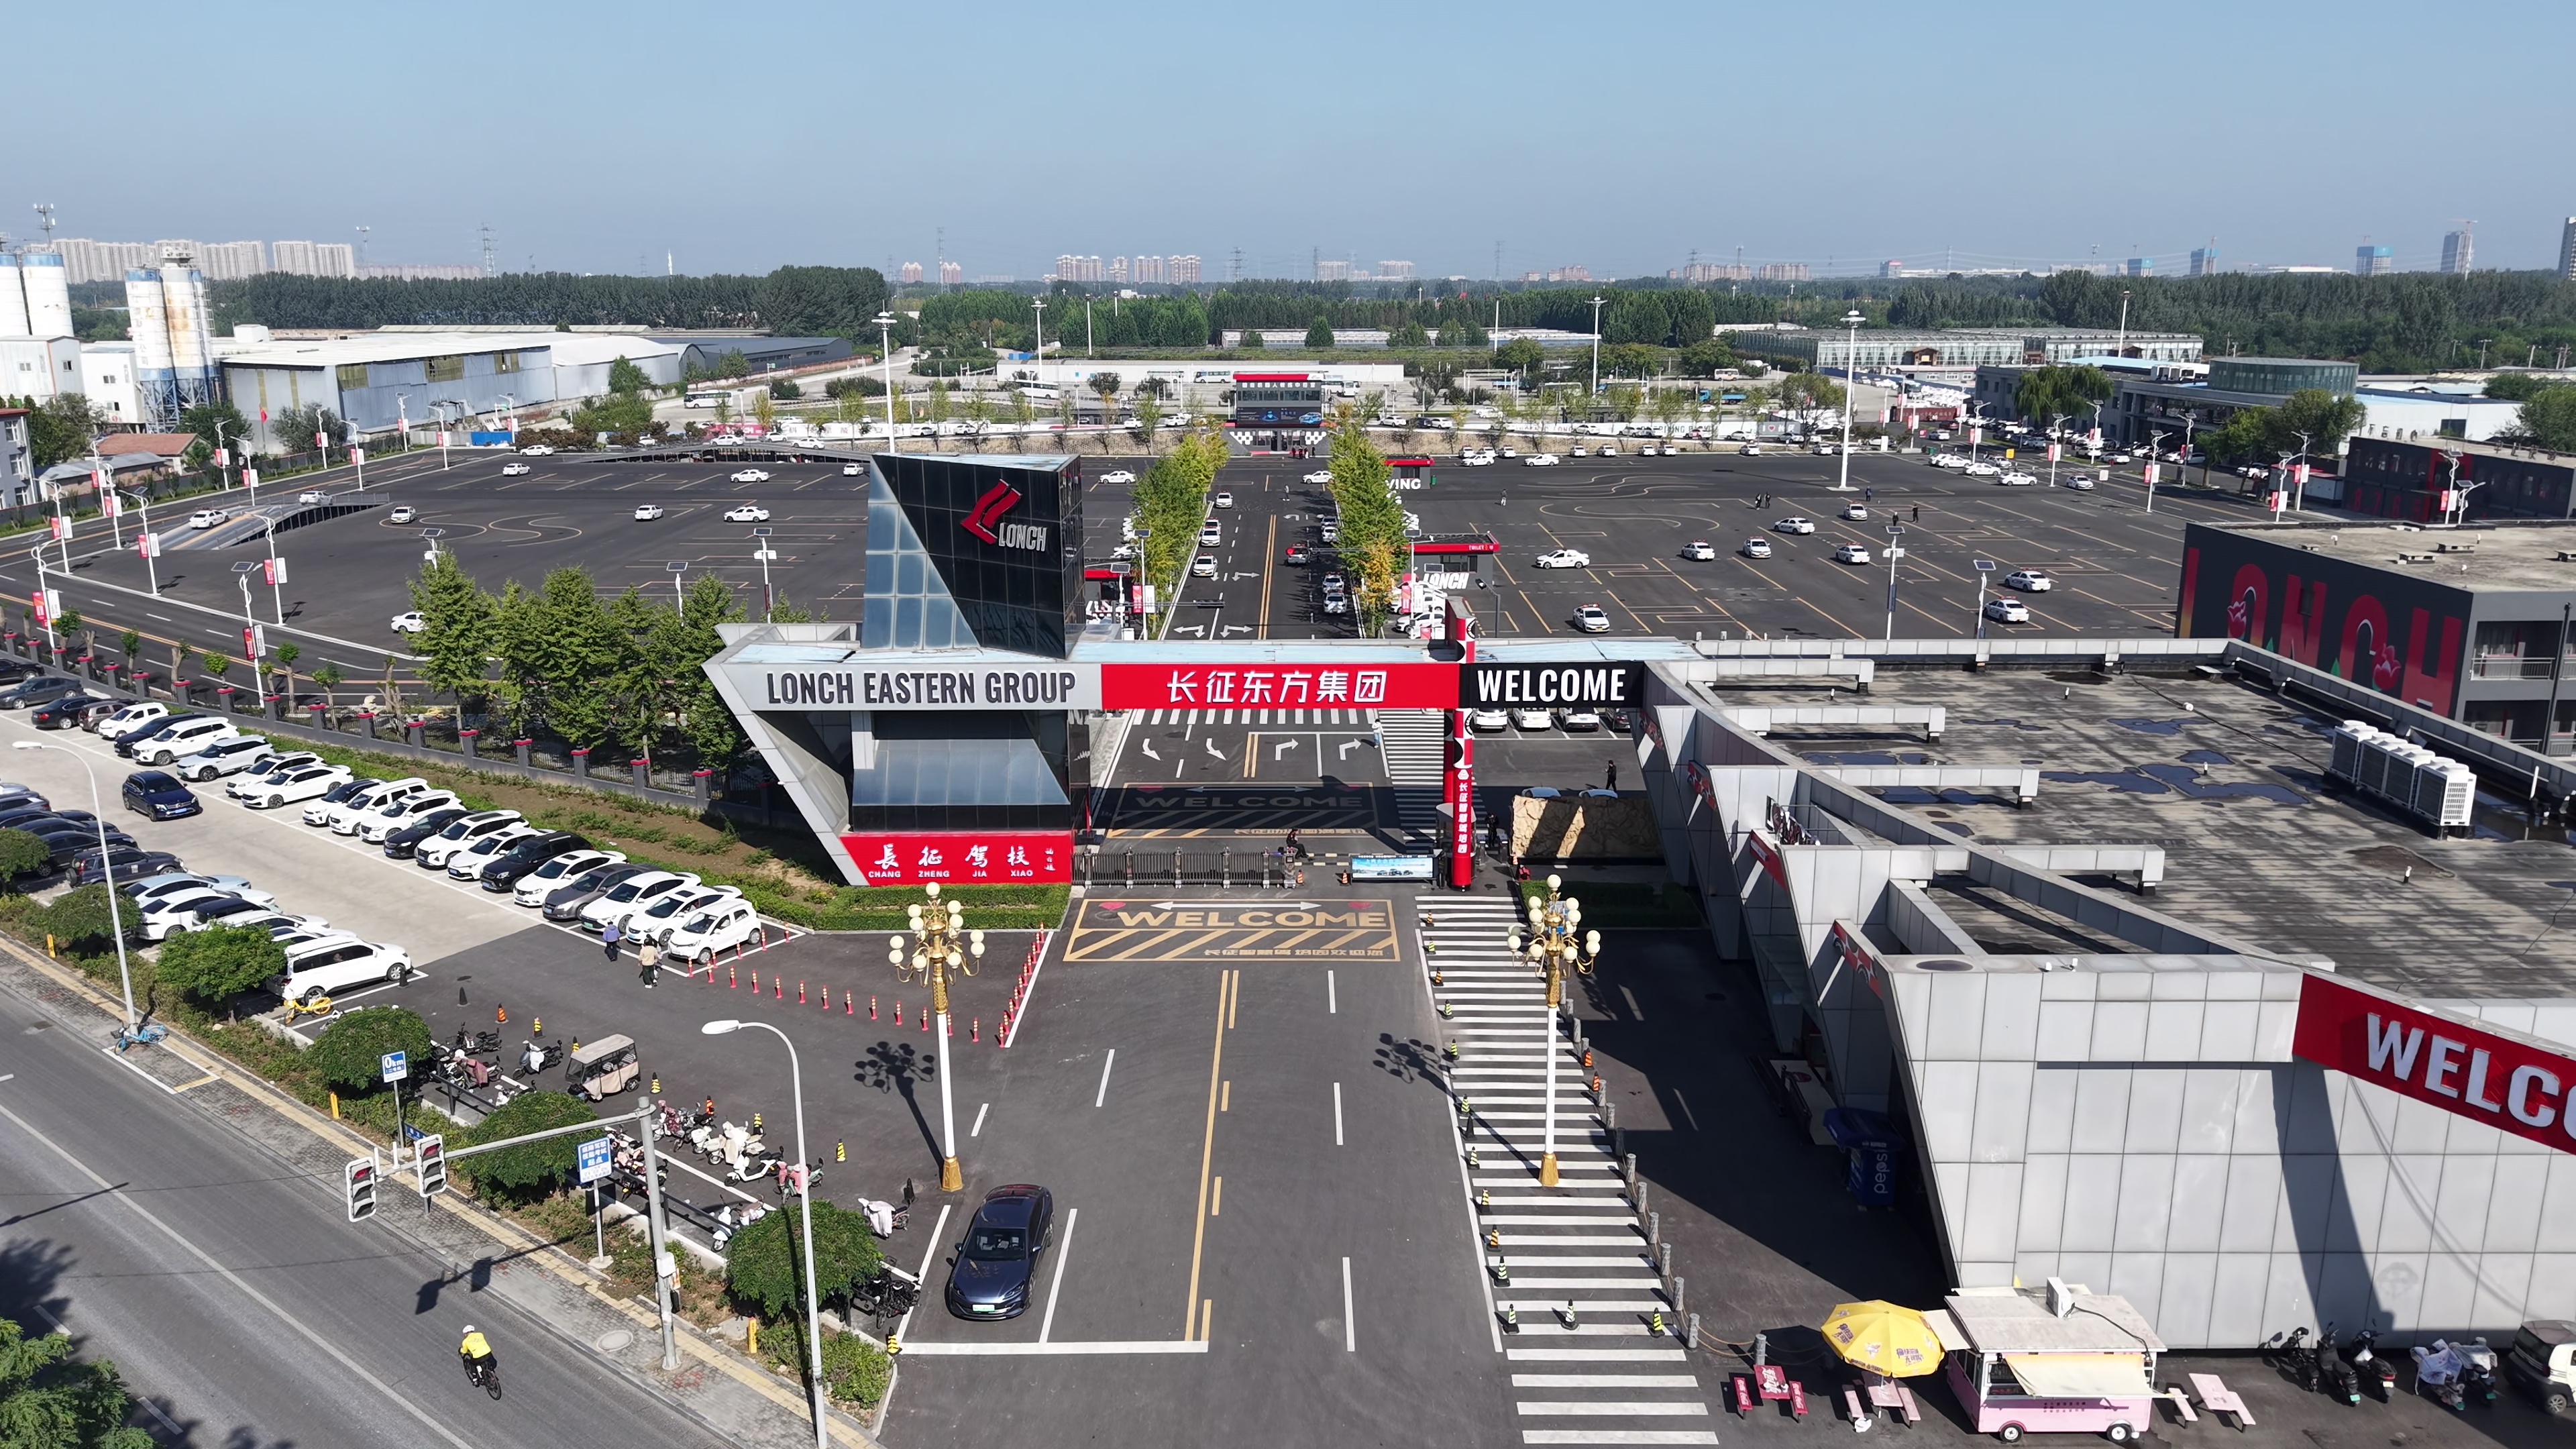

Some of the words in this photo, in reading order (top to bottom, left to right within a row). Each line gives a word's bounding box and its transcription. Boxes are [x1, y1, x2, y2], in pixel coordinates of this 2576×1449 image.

[1385, 478, 1421, 490] VING
[998, 523, 1047, 552] LONCH
[1424, 573, 1470, 589] LONCH
[767, 672, 855, 704] LONCH
[863, 672, 976, 704] EASTERN
[985, 671, 1076, 704] GROUP
[1167, 669, 1387, 703] 长征东方集团
[1478, 669, 1626, 702] WELCOME
[1136, 796, 1363, 807] WELCOME
[1117, 911, 1387, 927] WELCOME
[384, 1057, 404, 1069] 0km
